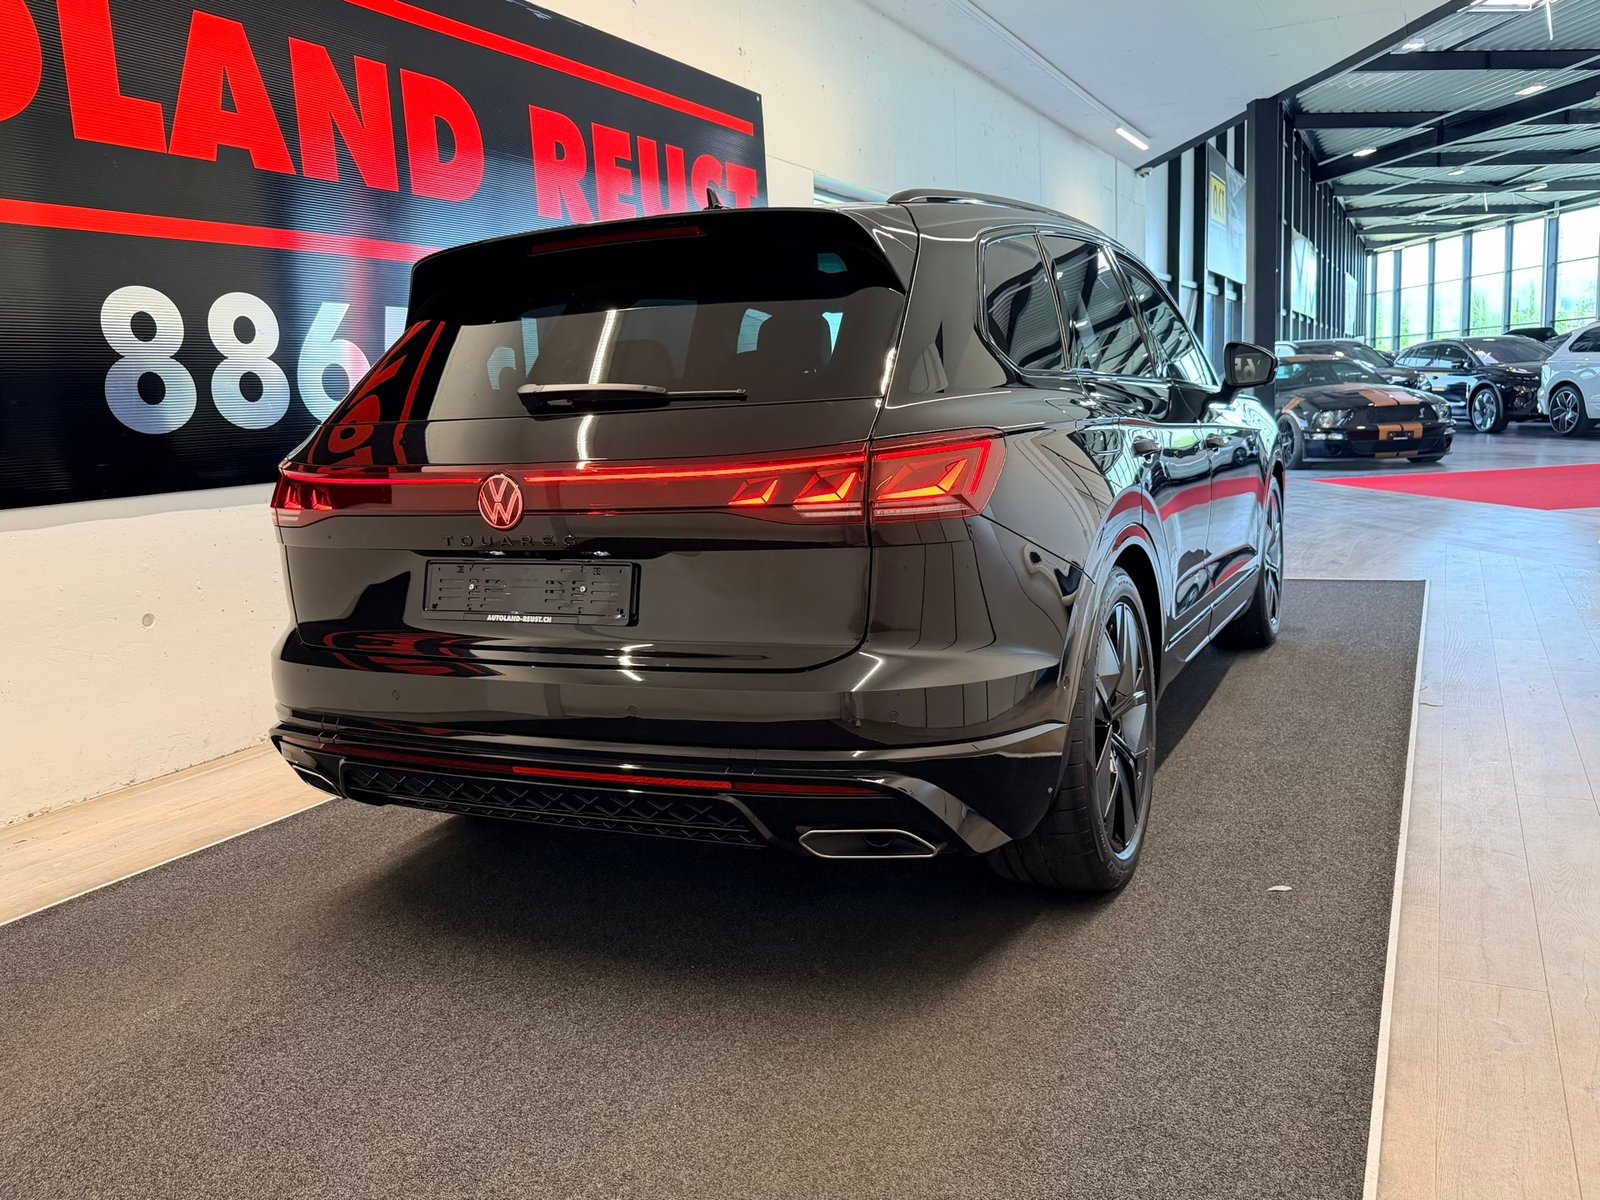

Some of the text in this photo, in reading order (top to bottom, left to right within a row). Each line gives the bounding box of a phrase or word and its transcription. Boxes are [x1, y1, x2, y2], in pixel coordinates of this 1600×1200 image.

[0, 0, 485, 201] LAND
[99, 285, 409, 435] 886
[441, 534, 578, 547] TOUAREG
[486, 614, 552, 623] AUTOLAND-REUST.CH
